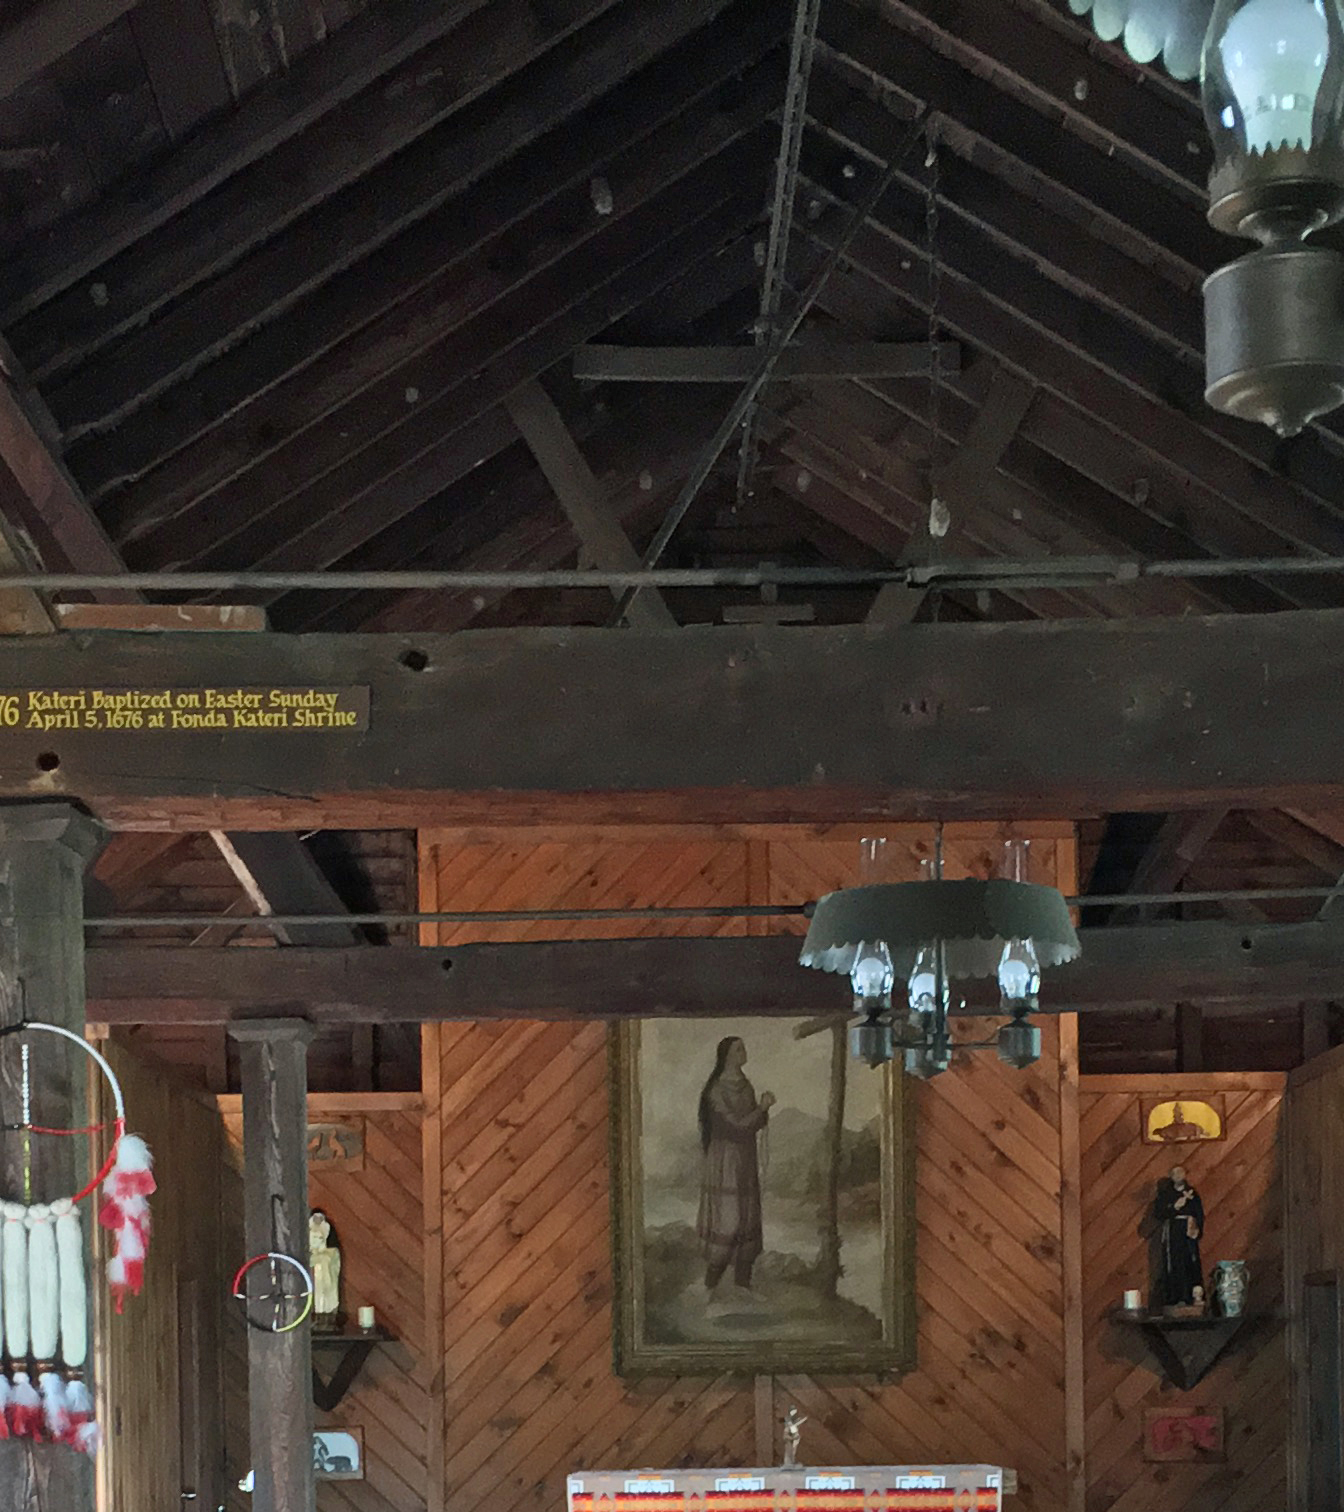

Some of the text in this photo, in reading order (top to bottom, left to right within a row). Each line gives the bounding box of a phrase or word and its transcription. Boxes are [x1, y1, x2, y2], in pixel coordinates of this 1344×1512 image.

[26, 689, 339, 713] Kateri Baptized on Easter Sunday
[25, 710, 80, 732] April
[148, 710, 165, 728] at
[170, 709, 229, 728] Fonda
[232, 708, 289, 728] Kateri
[292, 708, 358, 728] Shrine
